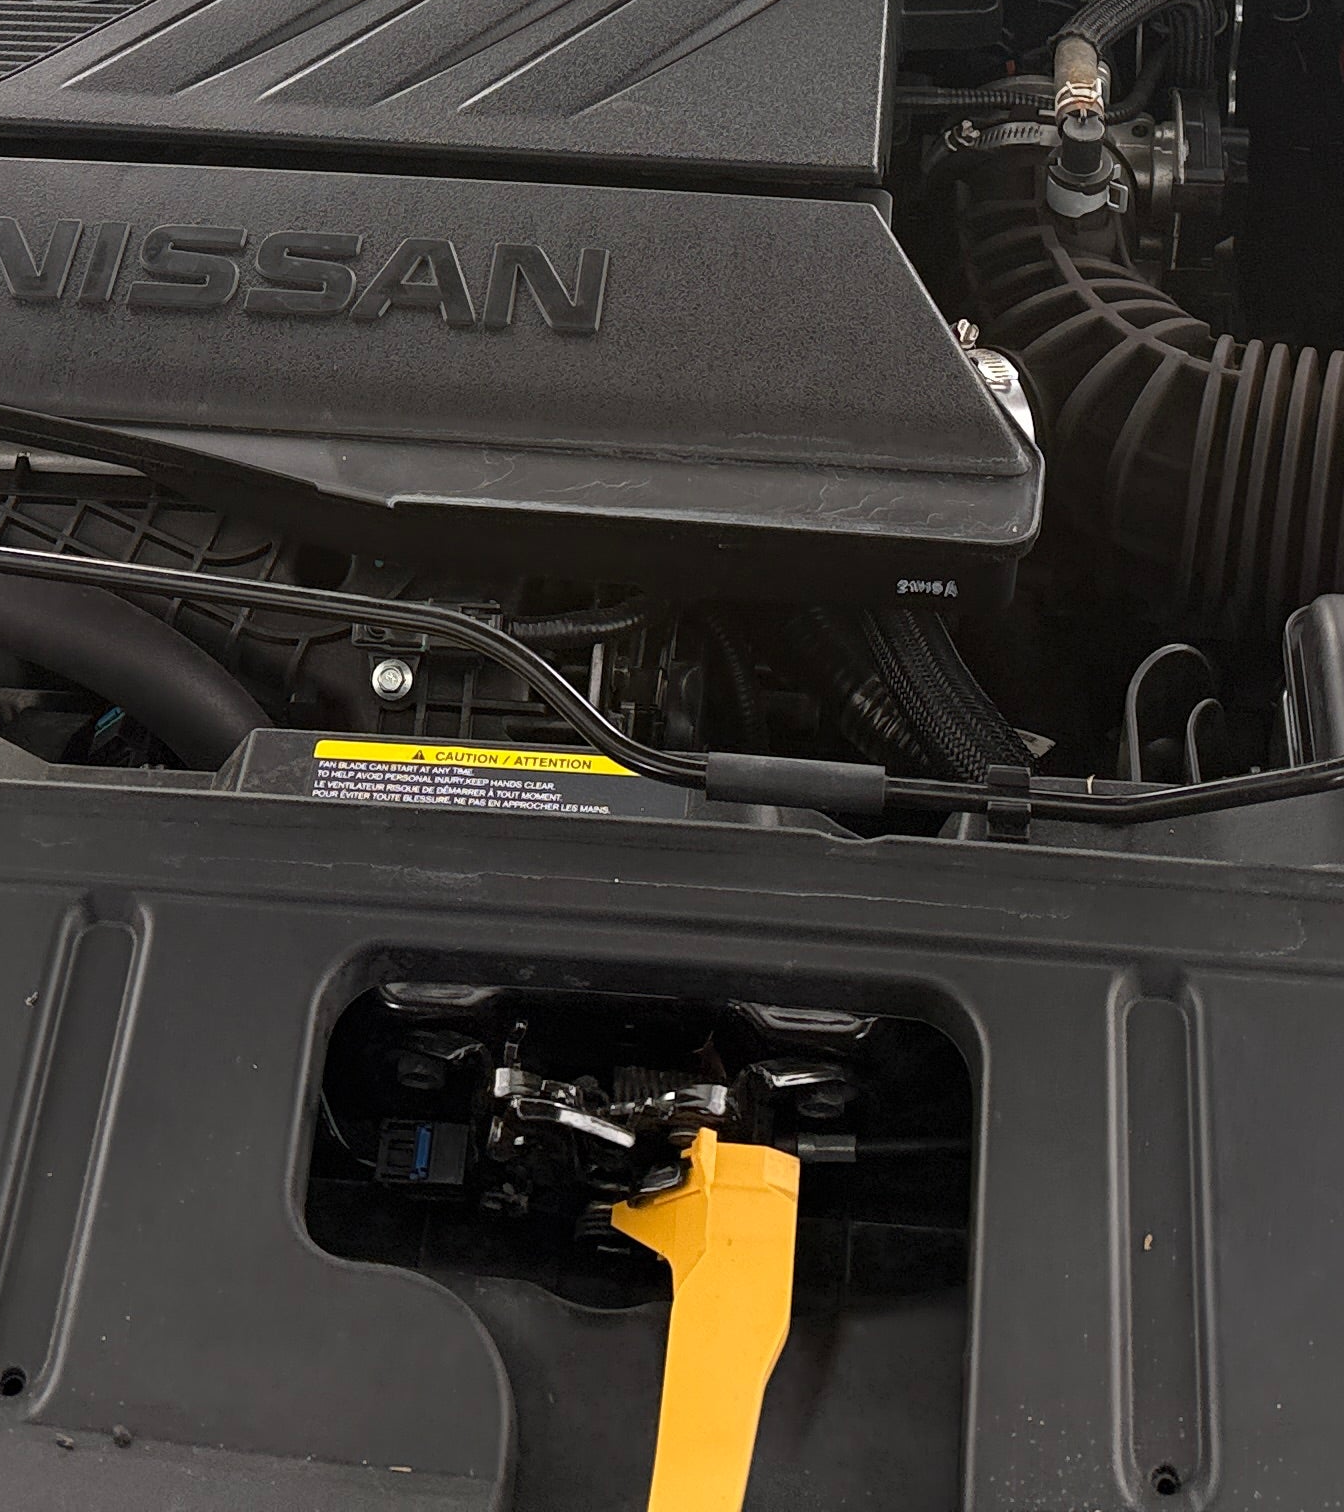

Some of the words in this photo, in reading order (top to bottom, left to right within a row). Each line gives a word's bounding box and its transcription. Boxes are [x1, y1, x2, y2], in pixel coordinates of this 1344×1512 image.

[319, 761, 337, 769] FAN
[338, 762, 367, 771] BLADE
[369, 763, 389, 771] CAN
[390, 764, 418, 773] START
[420, 765, 431, 773] AT
[432, 766, 451, 775] ANY
[435, 751, 499, 765] CAUTION
[502, 755, 510, 765] /
[513, 756, 592, 770] ATTENTION
[318, 770, 329, 778] TO
[331, 770, 355, 779] HELP
[356, 772, 383, 781] AVOID
[384, 773, 433, 784] PERSONAL
[490, 780, 522, 789] HANDS
[314, 780, 326, 788] LE
[327, 781, 385, 792] VENTILATEUR
[386, 784, 420, 794] RISQUE
[422, 785, 434, 794] DE
[436, 785, 486, 797] DÉMARRER
[496, 790, 520, 799] TOUT
[312, 789, 338, 799] POUR
[340, 789, 370, 800] ÉVITER
[372, 793, 401, 802] TOUTE
[453, 797, 466, 805] NE
[468, 798, 486, 807] PAS
[487, 799, 501, 808] EN
[502, 800, 559, 811] APPROCHER
[560, 803, 578, 812] LES
